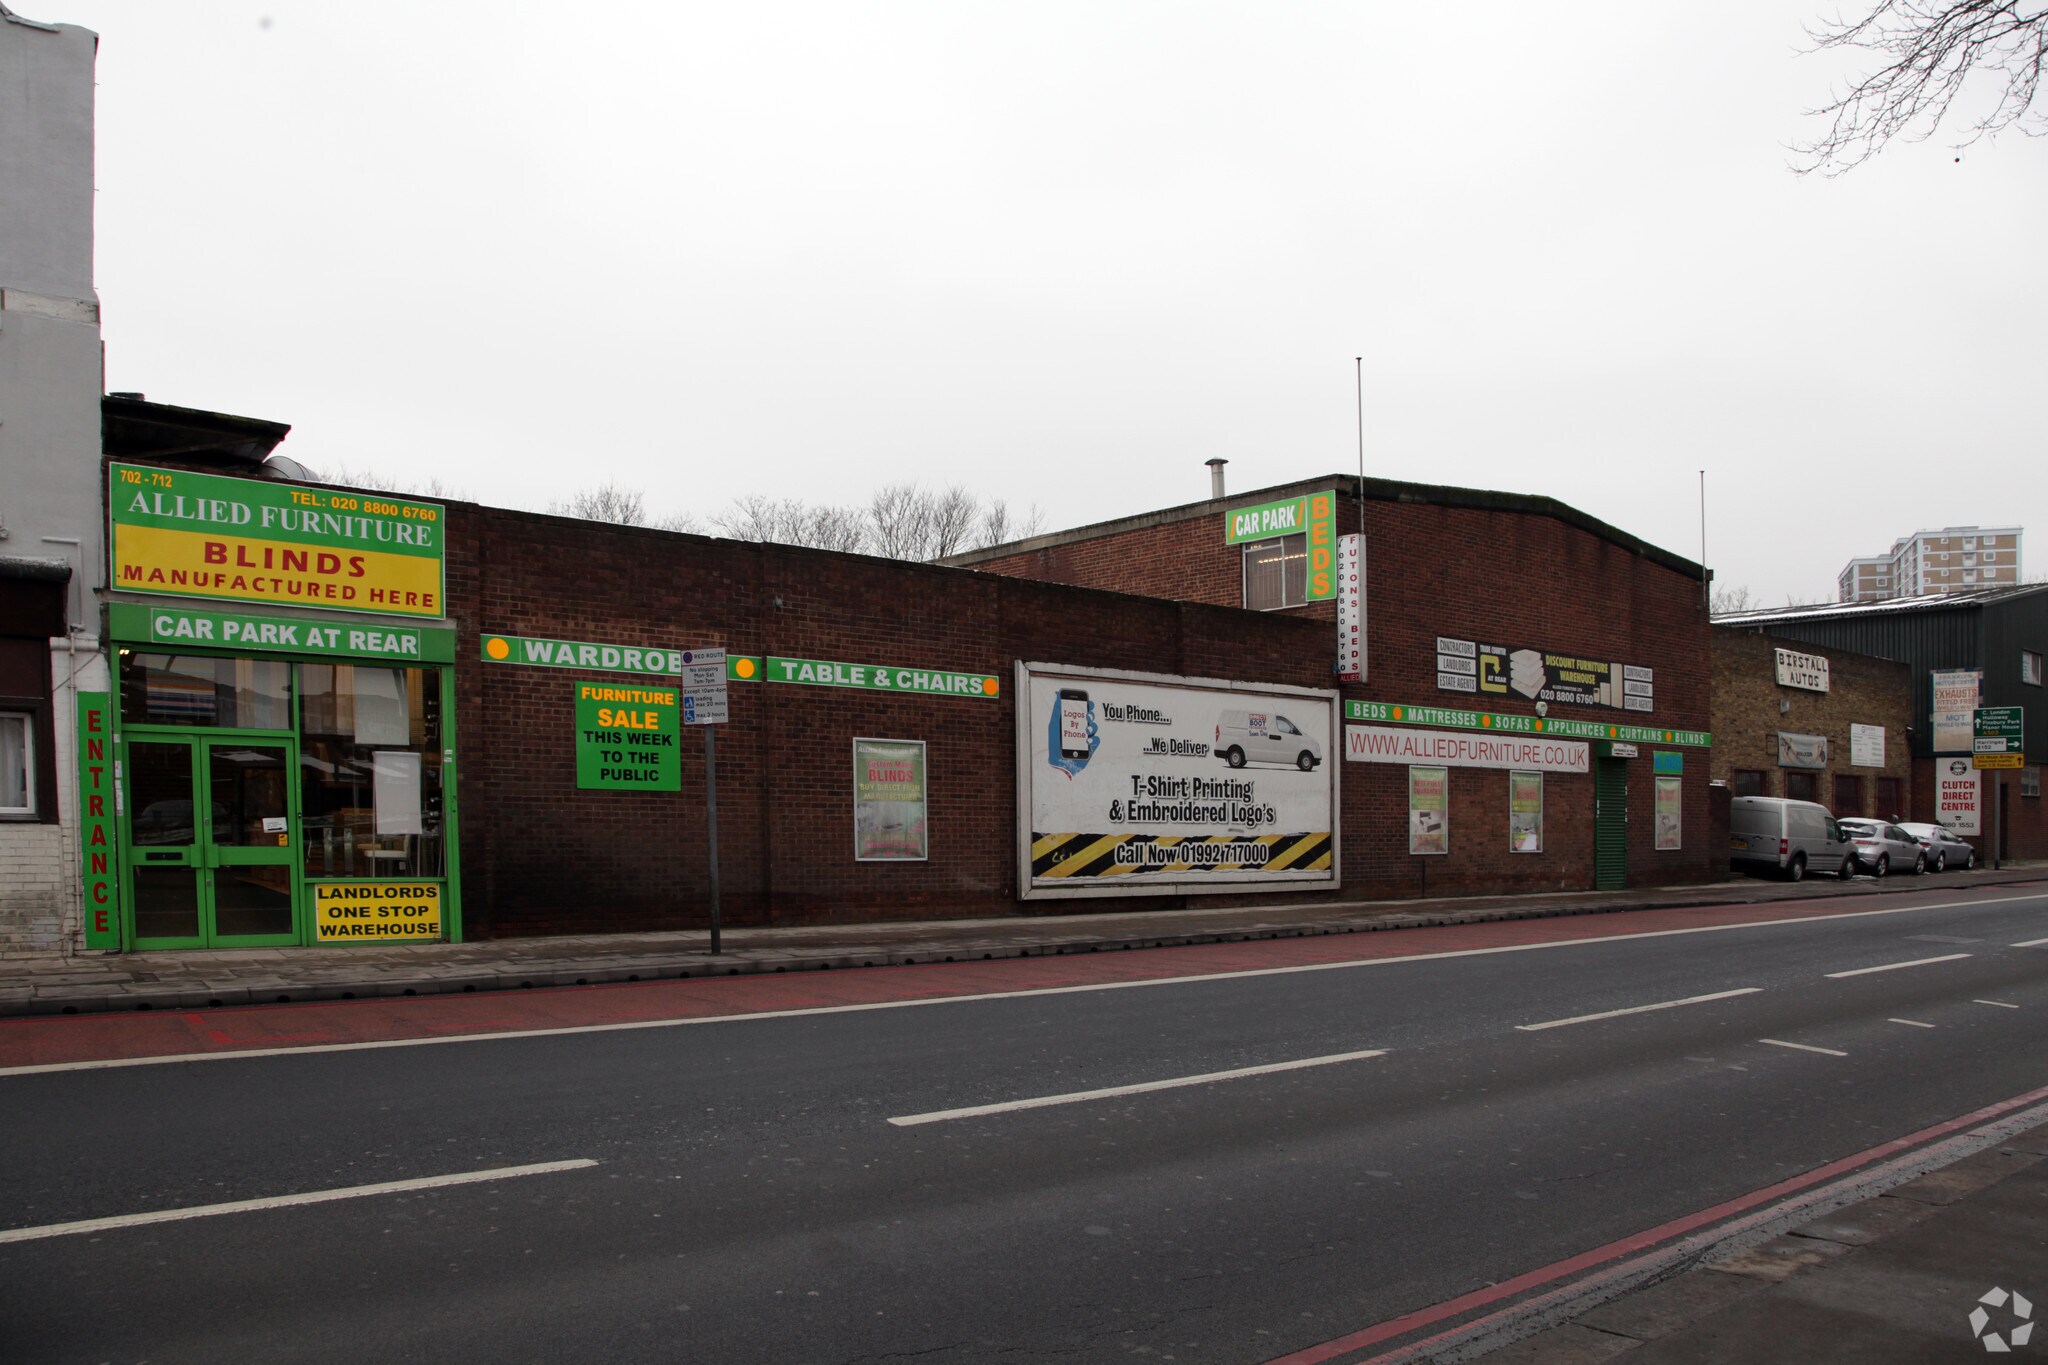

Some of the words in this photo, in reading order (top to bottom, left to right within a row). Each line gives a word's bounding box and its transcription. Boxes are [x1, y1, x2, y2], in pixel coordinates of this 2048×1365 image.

[120, 470, 141, 484] 702
[152, 474, 173, 488] 712
[290, 491, 326, 508] TEL:
[331, 496, 358, 511] 020
[363, 501, 398, 516] 8800
[402, 506, 437, 521] 6760
[128, 490, 251, 525] ALLIED
[260, 505, 433, 547] FURNITURE
[1236, 513, 1259, 536] CAR
[1262, 505, 1296, 532] PARK
[1312, 496, 1330, 596] BEDS
[204, 542, 366, 577] BLINDS
[1349, 536, 1358, 607] FUTONS
[123, 564, 357, 600] MANUFACTURED
[370, 588, 434, 608] HERE
[154, 615, 214, 639] CAR
[223, 620, 299, 646] PARK
[306, 627, 341, 649] AT
[350, 630, 418, 654] REAR
[1440, 640, 1474, 655] CONTRACTORS
[1443, 658, 1471, 672] LANDLORDS
[1545, 654, 1575, 668] DISCOUNT
[1576, 659, 1609, 673] FURNITURE
[1778, 652, 1828, 672] BIRSTALL
[781, 661, 865, 685] TABLE
[874, 669, 891, 687] &
[896, 671, 984, 694] CHAIRS
[1340, 673, 1360, 682] ALLIED
[1440, 675, 1456, 687] ESTATE
[1457, 677, 1475, 690] AGENTS
[1559, 670, 1596, 685] WAREHOUSE
[1790, 671, 1819, 687] AUTOS
[581, 687, 674, 705] FURNITURE
[1540, 689, 1555, 700] 020
[1556, 691, 1574, 702] 8800
[1576, 693, 1594, 704] 6760
[1935, 688, 1977, 699] EXHAUSTS
[598, 708, 659, 730] SALE
[1064, 710, 1085, 719] Logos
[1102, 703, 1122, 719] You
[1126, 705, 1171, 722] Phone...
[1070, 721, 1079, 729] By
[1354, 702, 1387, 719] BEDS
[1408, 708, 1476, 726] MATTRESSES
[1495, 715, 1530, 731] SOFAS
[1547, 721, 1605, 737] APPLIANCES
[1620, 727, 1662, 741] CURTAINS
[1675, 732, 1704, 744] BLINDS
[584, 731, 622, 744] THIS
[627, 732, 673, 747] WEEK
[1064, 730, 1086, 739] Phone
[1170, 739, 1208, 755] Deliver
[1350, 732, 1586, 766] WWW.ALLIEDFURNITURE.CO.UK
[600, 750, 623, 763] TO
[628, 751, 660, 764] THE
[600, 768, 660, 782] PUBLIC
[868, 769, 913, 782] BLINDS
[1131, 774, 1188, 798] T-Shirt
[1193, 777, 1252, 803] Printing
[1942, 780, 1975, 789] CLUTCH
[1942, 791, 1974, 800] DIRECT
[1109, 799, 1123, 821] &
[1127, 800, 1226, 822] Embroidered
[1231, 803, 1275, 827] Logo's
[1941, 802, 1975, 811] CENTRE
[87, 710, 109, 933] ENTRANCE
[1116, 844, 1143, 864] Call
[1148, 845, 1177, 863] Now
[318, 887, 437, 899] LANDLORDS
[328, 906, 371, 918] ONE
[378, 906, 429, 917] STOP
[320, 923, 439, 936] WAREHOUSE
